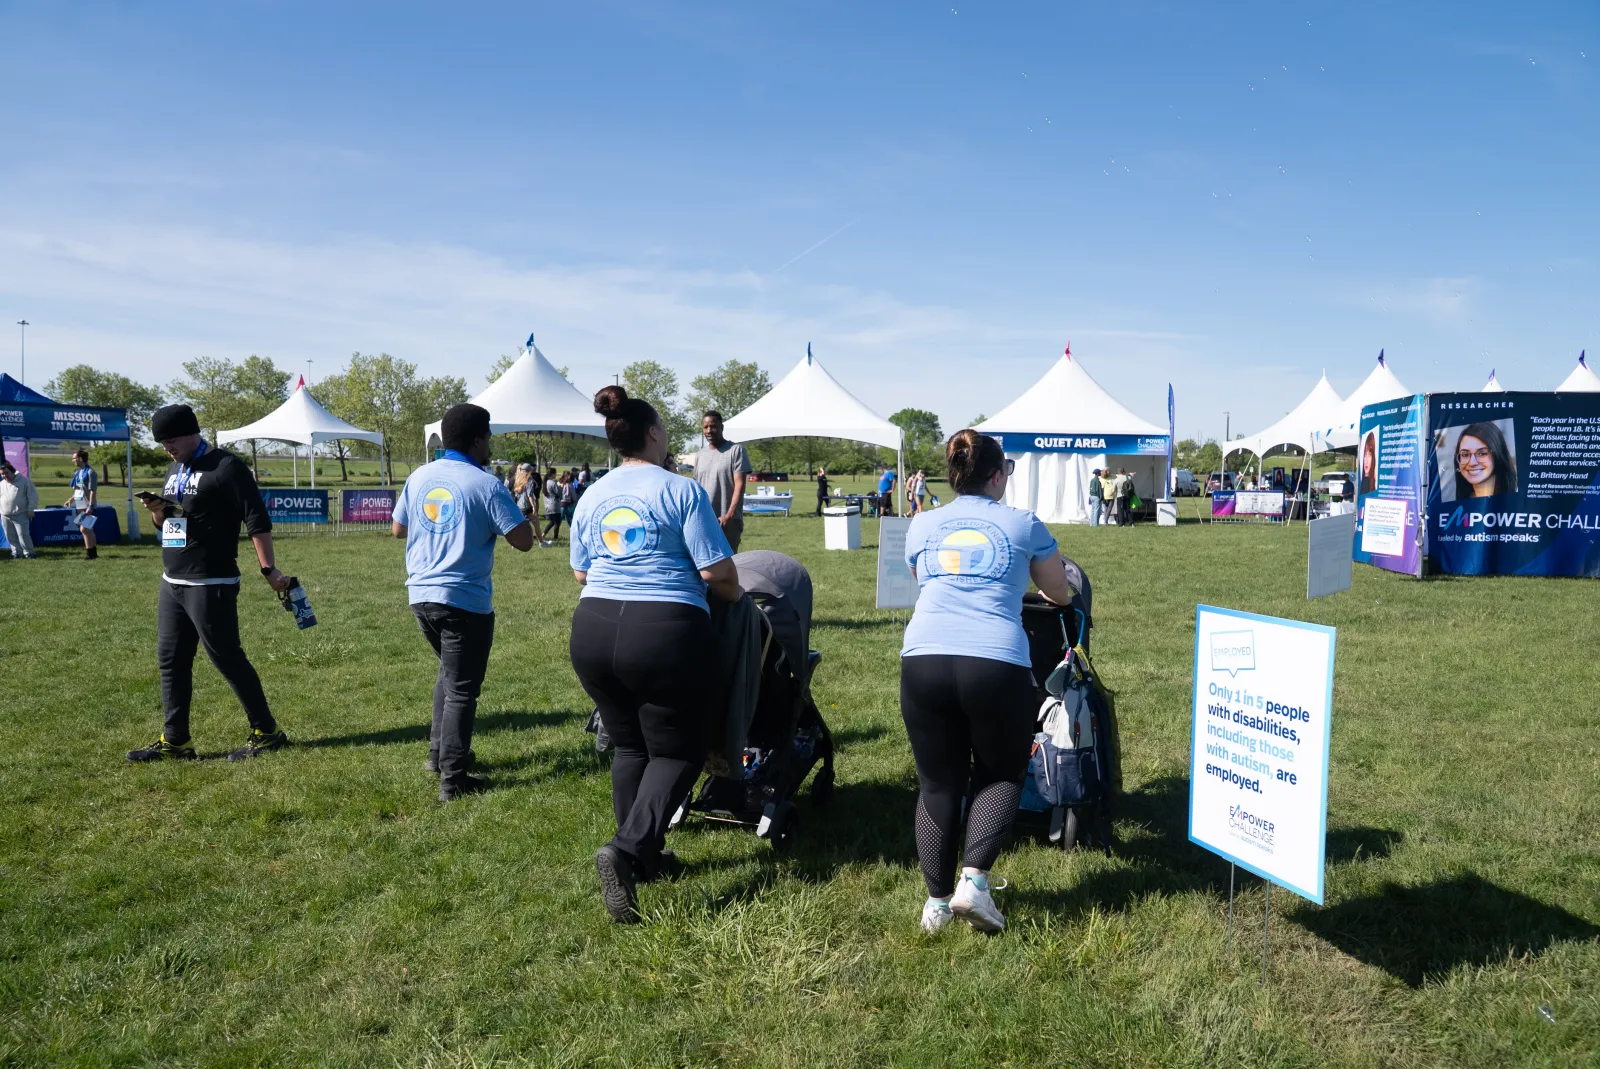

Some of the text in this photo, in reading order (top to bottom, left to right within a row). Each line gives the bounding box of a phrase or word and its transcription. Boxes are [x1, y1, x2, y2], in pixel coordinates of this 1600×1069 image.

[1440, 401, 1514, 410] RESEARCHER
[53, 411, 101, 423] MISSION
[1568, 416, 1576, 424] in
[51, 421, 106, 432] IN ACTION
[1532, 425, 1556, 433] people
[1573, 425, 1584, 433] 18.
[1034, 436, 1107, 449] QUIET AREA
[1546, 433, 1567, 441] issues
[1568, 433, 1591, 442] facing
[1531, 442, 1540, 450] of
[1560, 450, 1582, 458] better
[1529, 471, 1589, 480] Dr. Brittany Hand
[1438, 505, 1542, 531] EMPOWER
[1454, 534, 1463, 543] by
[1464, 532, 1499, 542] autism
[1499, 532, 1541, 543] speaks
[1213, 646, 1252, 657] EMPLOYED
[1208, 682, 1310, 723] Only 1 in 5 people
[1207, 702, 1301, 745] with disabilities,
[1207, 719, 1295, 763] including those
[1206, 742, 1298, 786] with autism, are
[1205, 762, 1263, 795] employed.
[1229, 804, 1275, 834] EMPOWER
[1228, 817, 1275, 846] CHALLENGE
